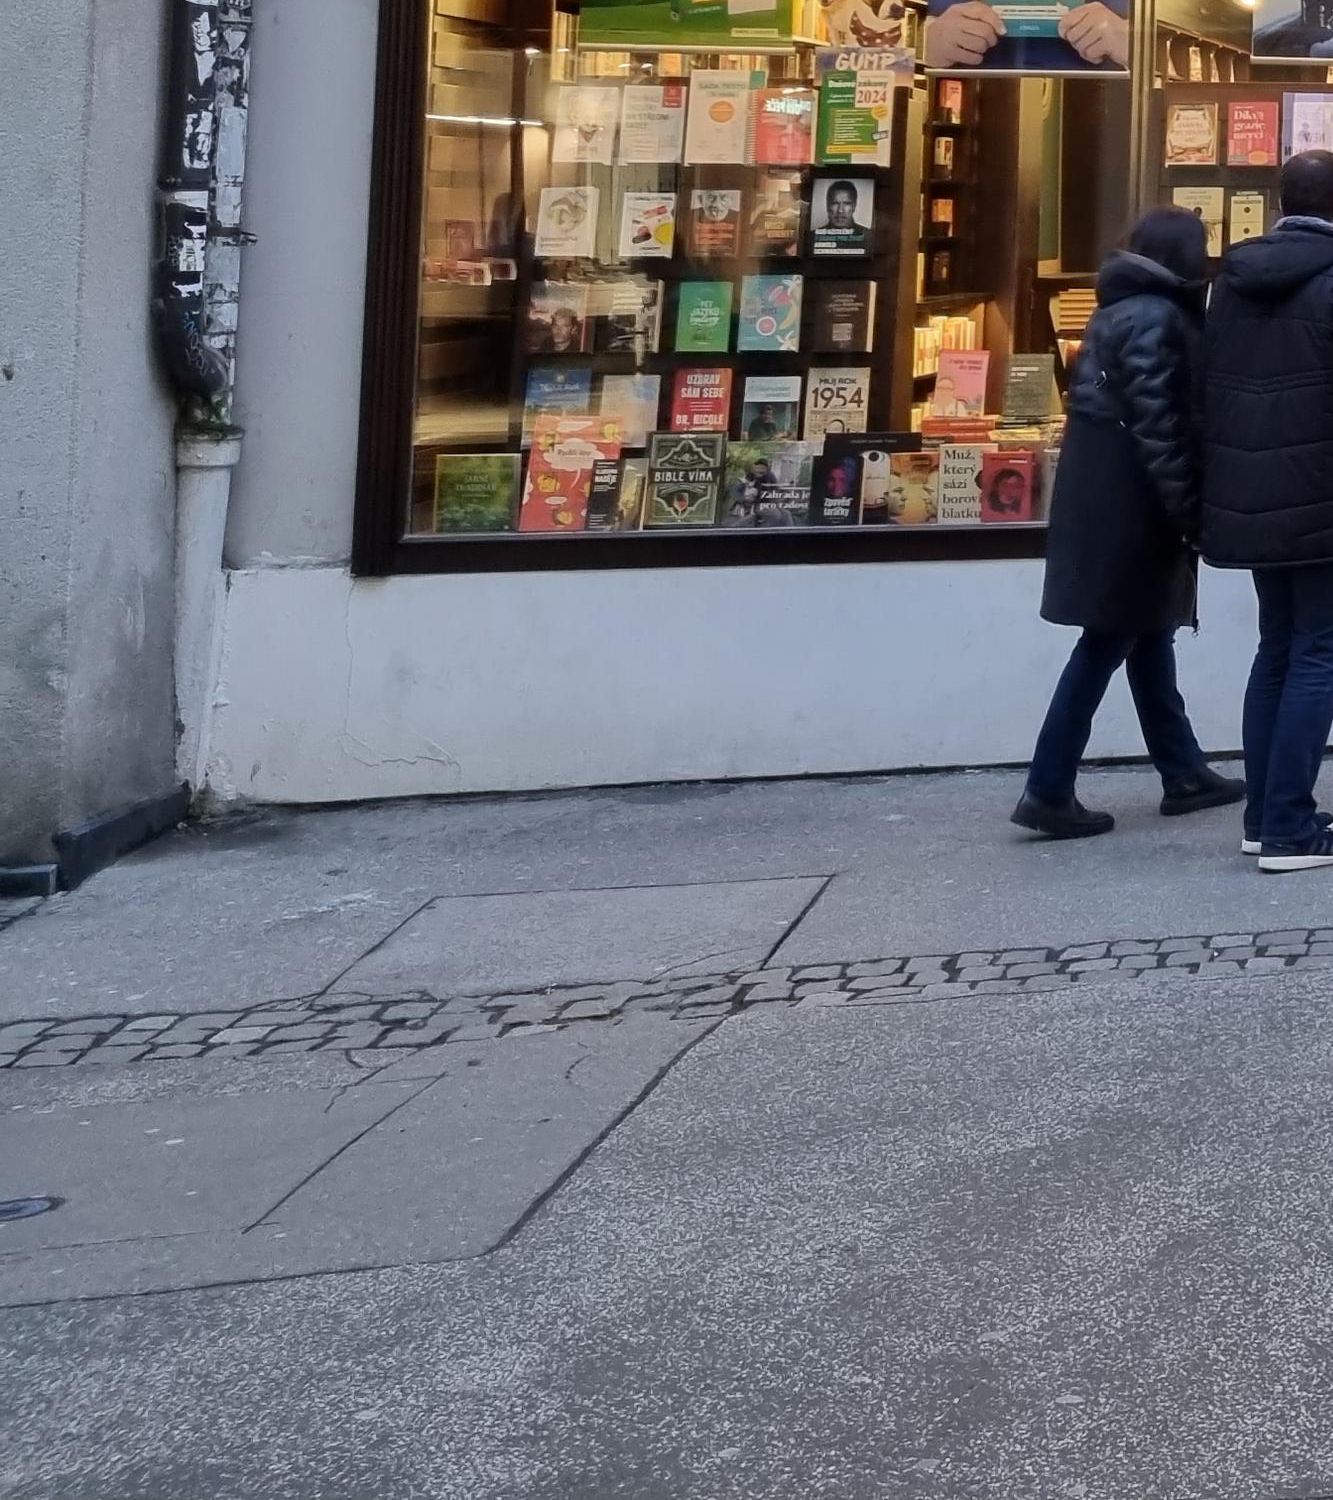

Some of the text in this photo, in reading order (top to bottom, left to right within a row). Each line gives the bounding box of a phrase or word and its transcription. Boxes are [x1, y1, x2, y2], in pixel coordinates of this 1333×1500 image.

[835, 52, 897, 71] GUMP
[857, 90, 887, 104] 2024
[811, 386, 864, 409] 1954
[943, 449, 976, 462] Muž,
[654, 470, 713, 483] BIBLE VÍNA
[943, 464, 976, 478] který
